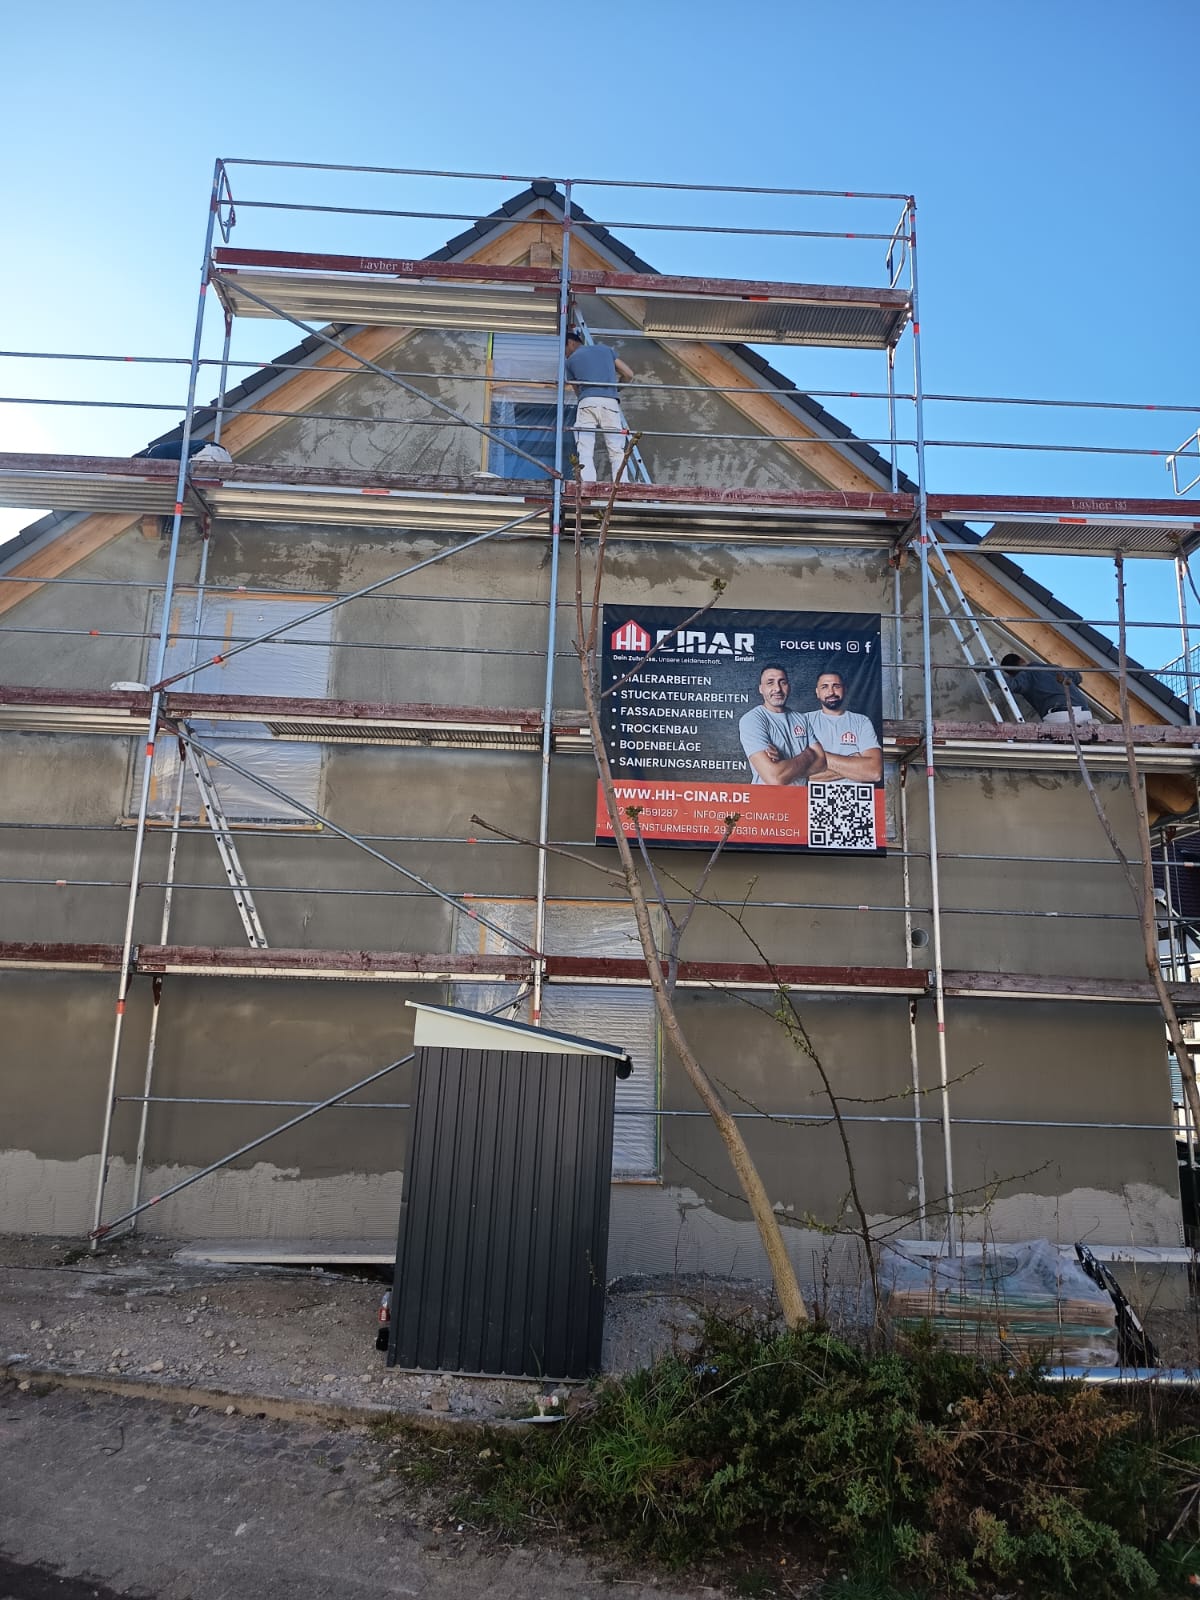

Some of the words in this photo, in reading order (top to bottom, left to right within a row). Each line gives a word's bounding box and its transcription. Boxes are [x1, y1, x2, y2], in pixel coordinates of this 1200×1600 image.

[656, 629, 755, 655] CINAR
[780, 640, 816, 650] FOLGE
[817, 641, 842, 651] UNS
[734, 655, 755, 663] GmbH
[620, 690, 749, 704] STUCKATEURARBEITEN
[620, 706, 734, 720] FASSADENARBEITEN
[620, 722, 698, 735] TROCKENBAU
[619, 739, 702, 752] BODENBELÄGE
[619, 757, 747, 771] SANIERUNGSARBEITEN
[760, 827, 800, 838] MALSCH
